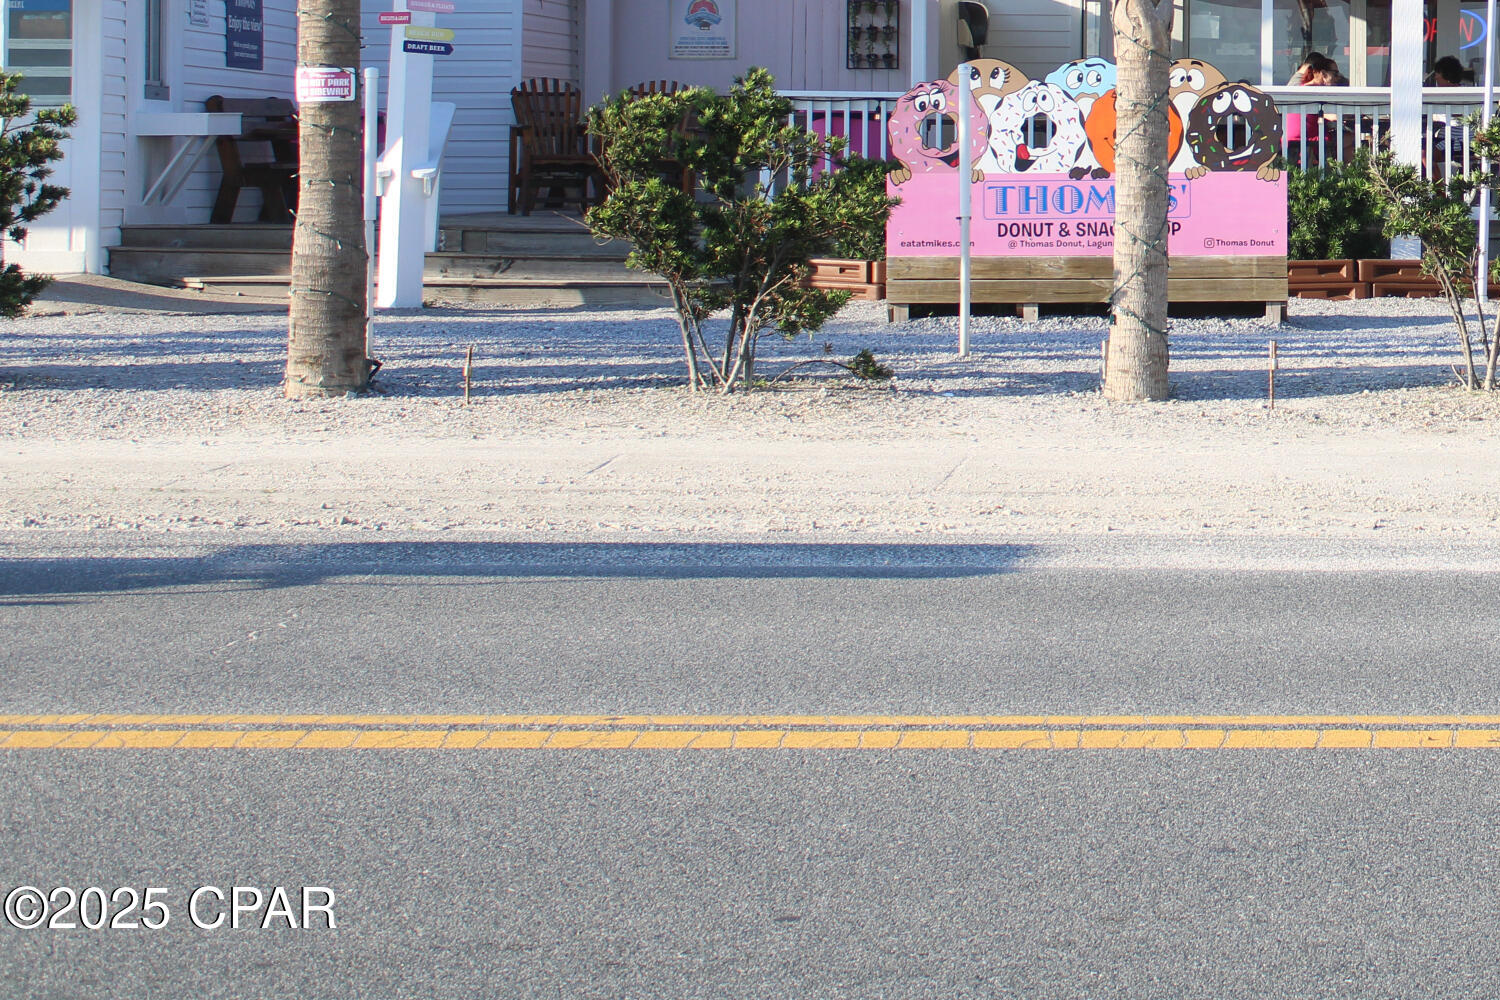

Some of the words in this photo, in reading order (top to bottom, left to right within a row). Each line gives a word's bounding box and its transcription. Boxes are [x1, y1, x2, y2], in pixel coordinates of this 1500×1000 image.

[407, 43, 428, 51] DRAFT
[429, 45, 446, 53] BEER
[327, 78, 350, 88] PARK
[997, 222, 1053, 238] DONUT
[1058, 222, 1071, 237] &
[900, 239, 975, 248] eatatmikes.cm
[1008, 240, 1018, 249] @
[1020, 239, 1054, 248] Thomas
[1056, 239, 1085, 249] Donut,
[1087, 239, 1115, 250] Lagun
[1216, 238, 1248, 248] Thomas
[1250, 238, 1275, 247] Donut
